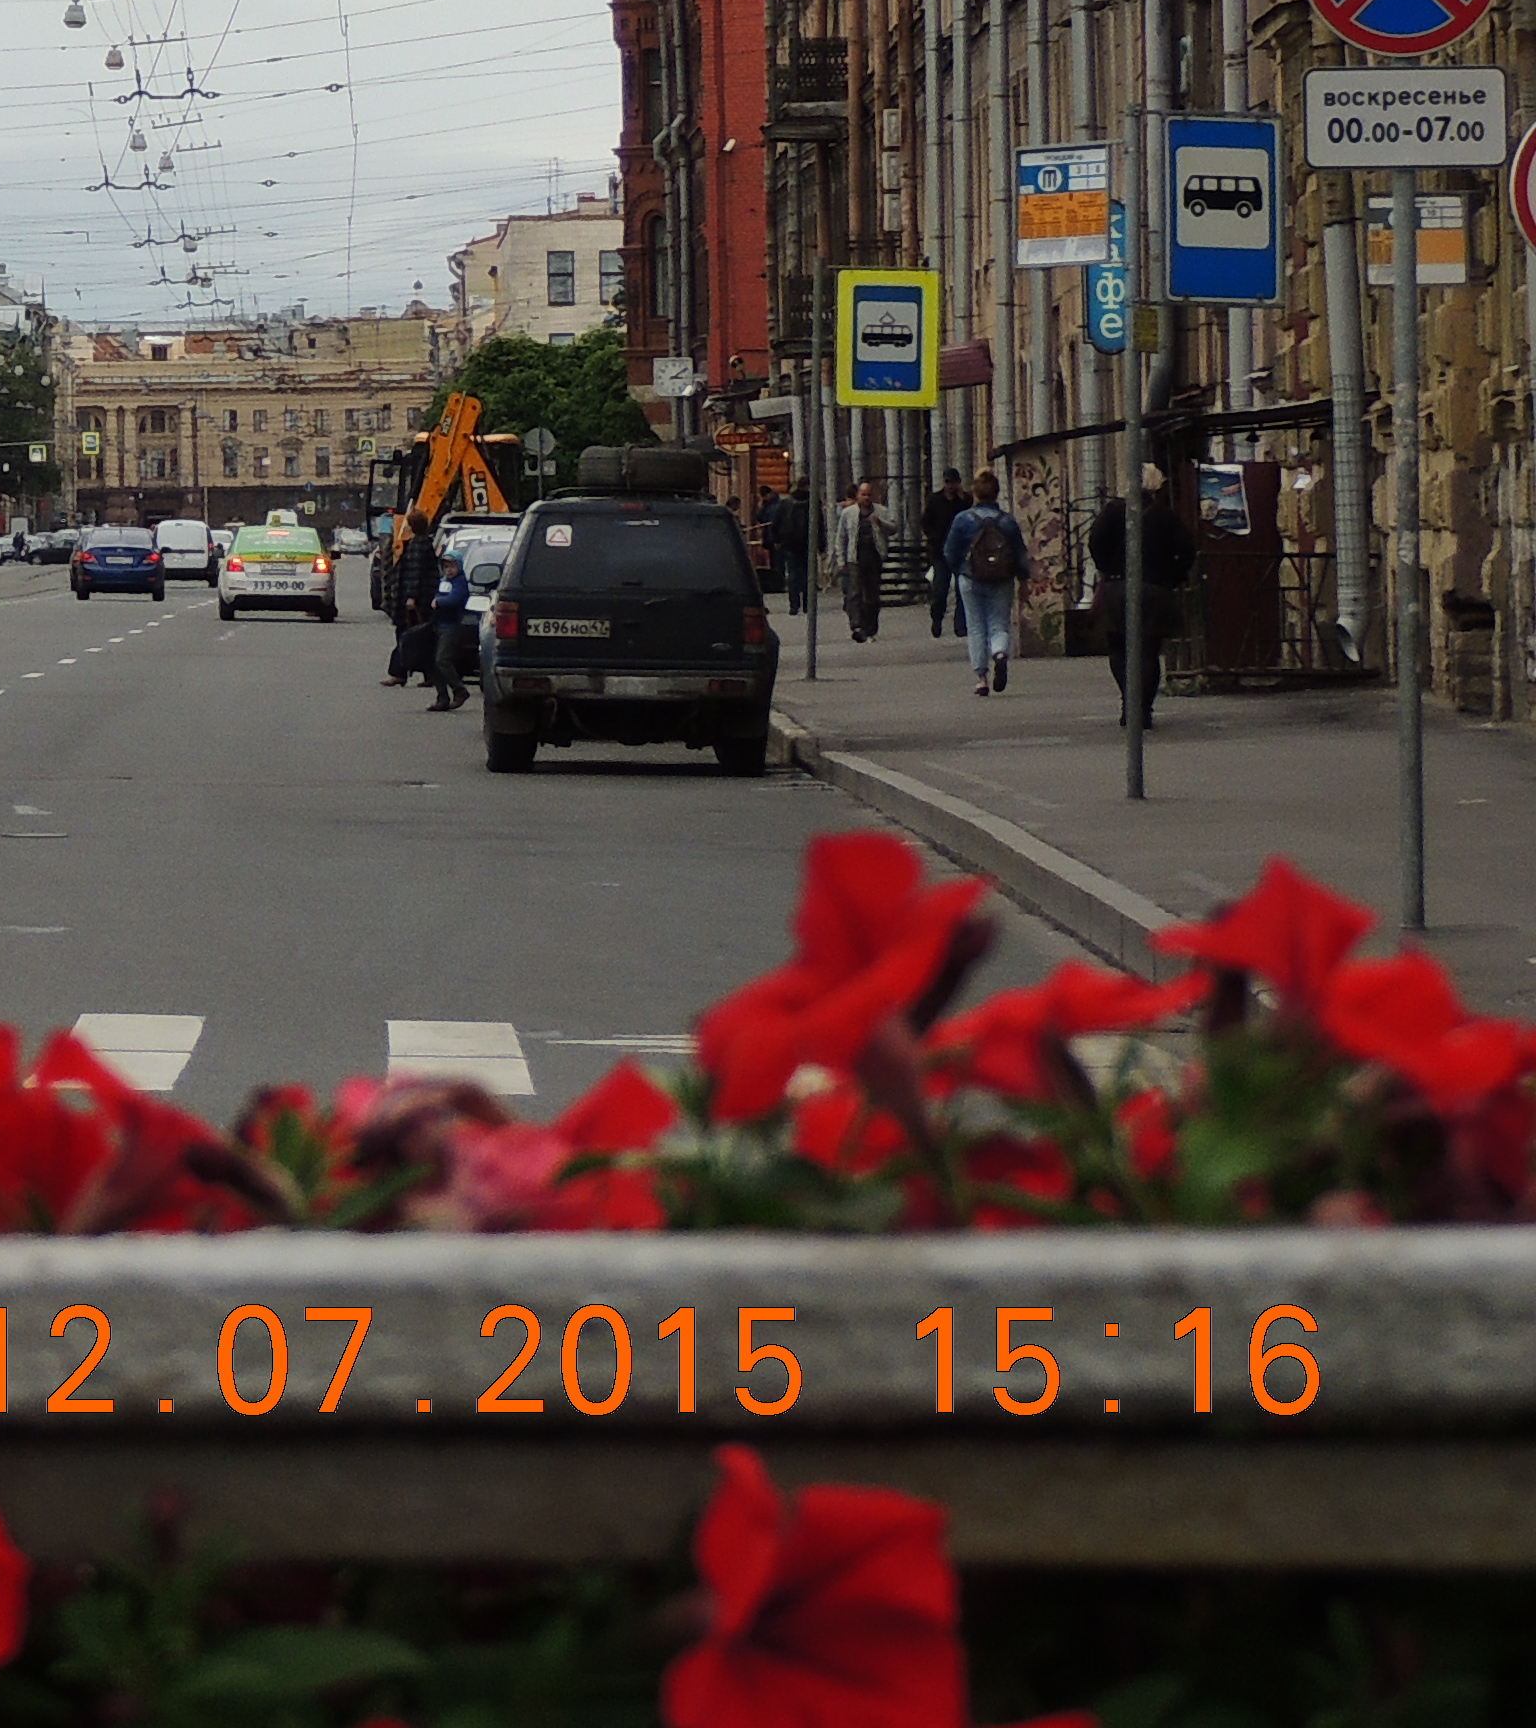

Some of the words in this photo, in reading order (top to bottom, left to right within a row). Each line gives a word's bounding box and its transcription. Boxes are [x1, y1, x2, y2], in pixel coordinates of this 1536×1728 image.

[1323, 90, 1487, 112] воскресенье
[1328, 116, 1485, 144] 00.00-07.00
[253, 580, 306, 591] 333-00-00
